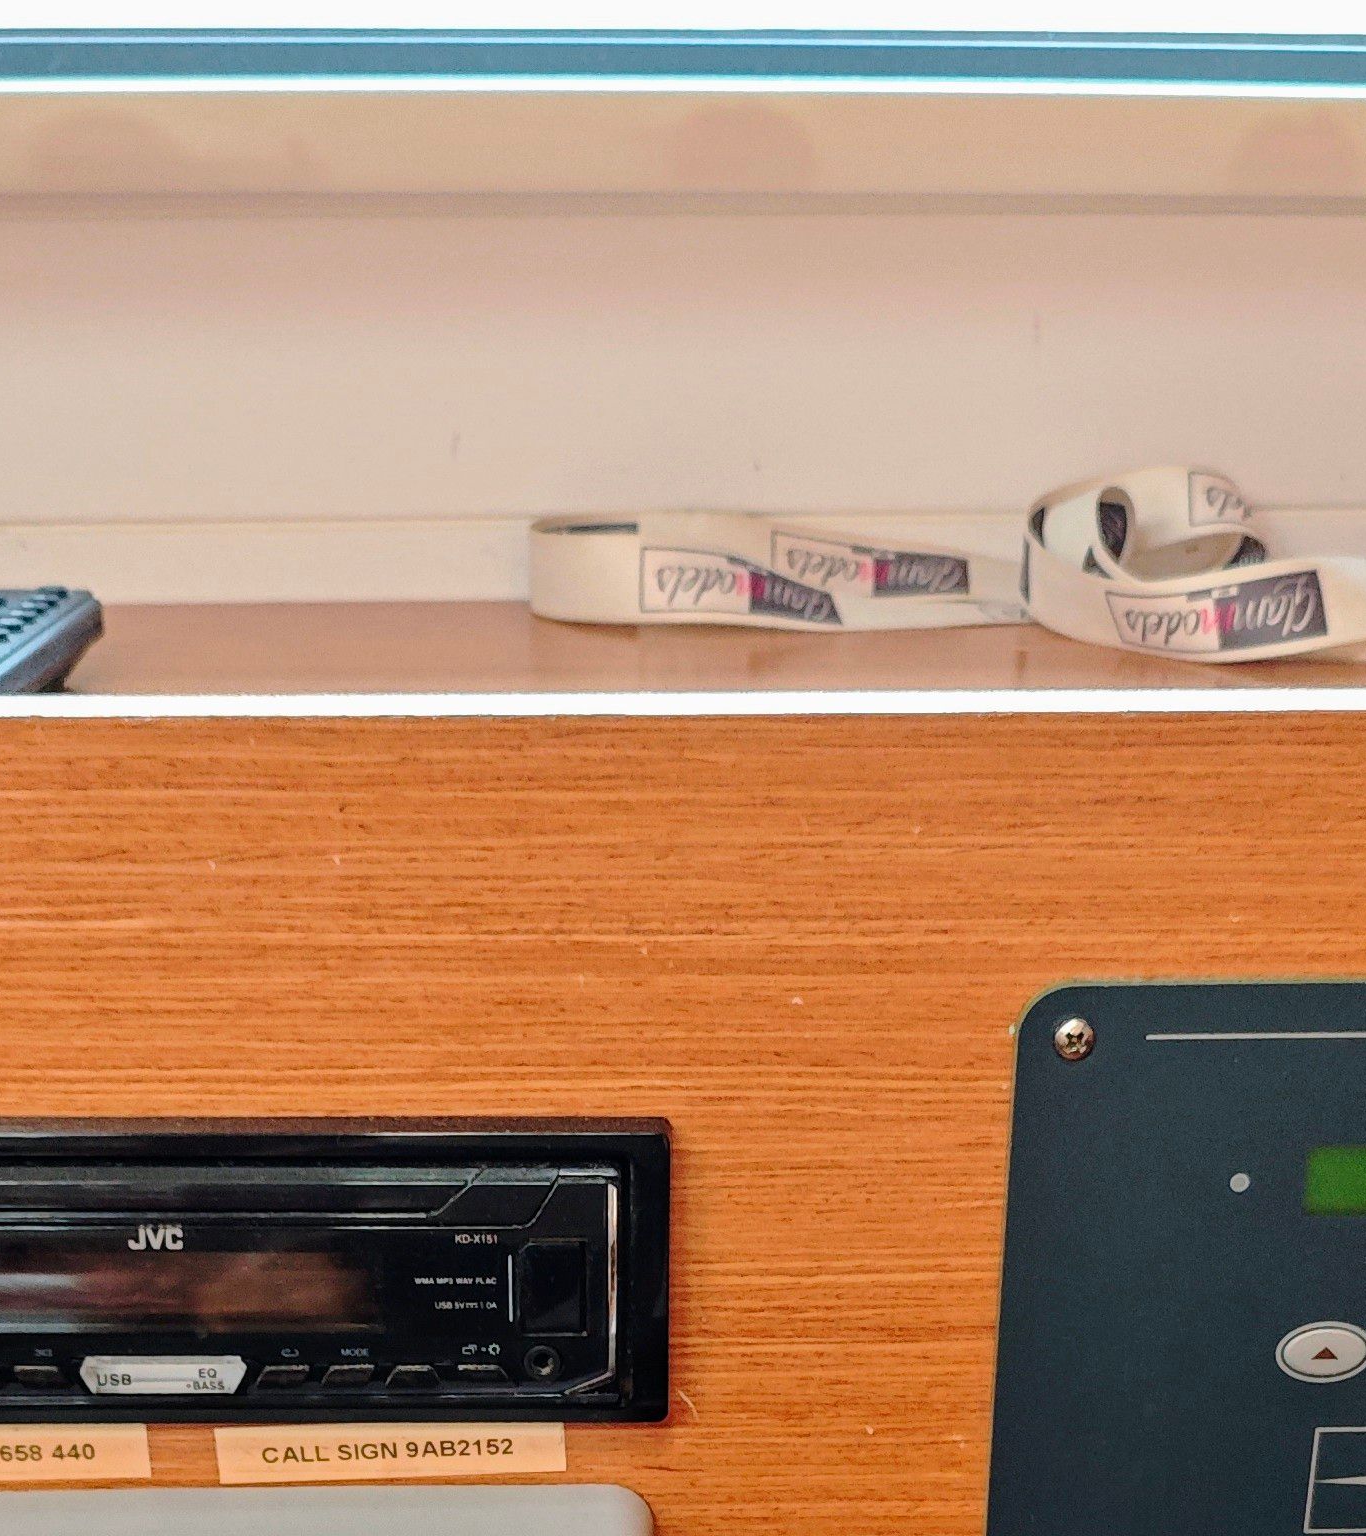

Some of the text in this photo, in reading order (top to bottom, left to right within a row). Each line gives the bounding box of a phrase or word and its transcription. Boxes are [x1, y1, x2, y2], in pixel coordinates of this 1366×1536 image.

[128, 1224, 184, 1250] JVC
[434, 1301, 453, 1309] USB
[341, 1348, 369, 1357] MODE
[97, 1373, 132, 1387] USB
[198, 1368, 217, 1379] EQ
[0, 1444, 43, 1462] 658
[51, 1443, 96, 1460] 440
[262, 1438, 514, 1463] CALL SIGN 9AB2152
